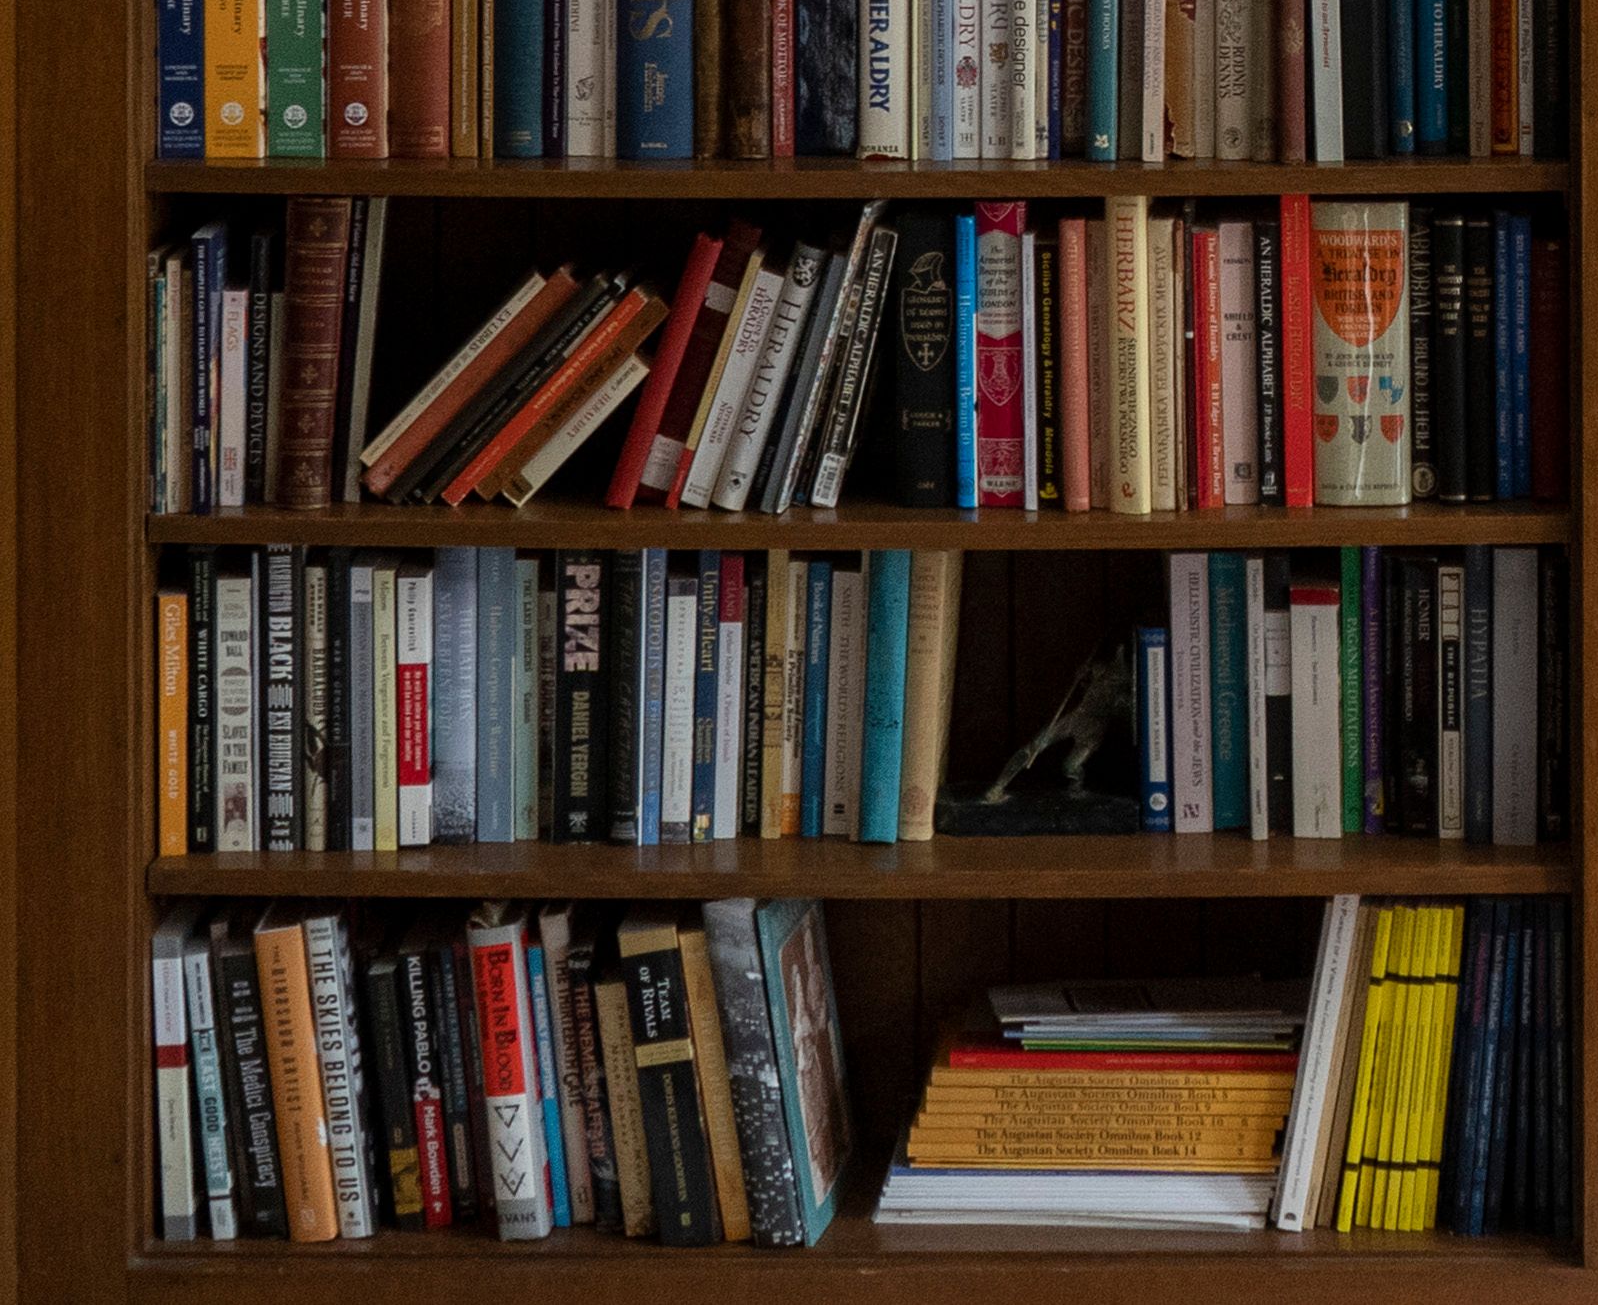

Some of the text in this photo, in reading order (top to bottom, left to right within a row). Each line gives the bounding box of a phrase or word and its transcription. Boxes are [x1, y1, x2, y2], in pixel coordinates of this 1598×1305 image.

[1012, 16, 1030, 89] designer
[1116, 215, 1136, 335] HERBARZ
[250, 293, 267, 464] DESIGNS AND DEVICES
[166, 604, 181, 695] Giles Milton
[270, 616, 293, 680] BLACK
[566, 563, 600, 671] PRIZE
[198, 629, 208, 717] WHITE CARGO
[571, 690, 589, 796] DANIEL YERGIN
[407, 957, 431, 1071] KILLING PABLO
[312, 949, 359, 1200] THE SKIES BELONG TO US
[424, 1105, 442, 1194] Mark Bowden
